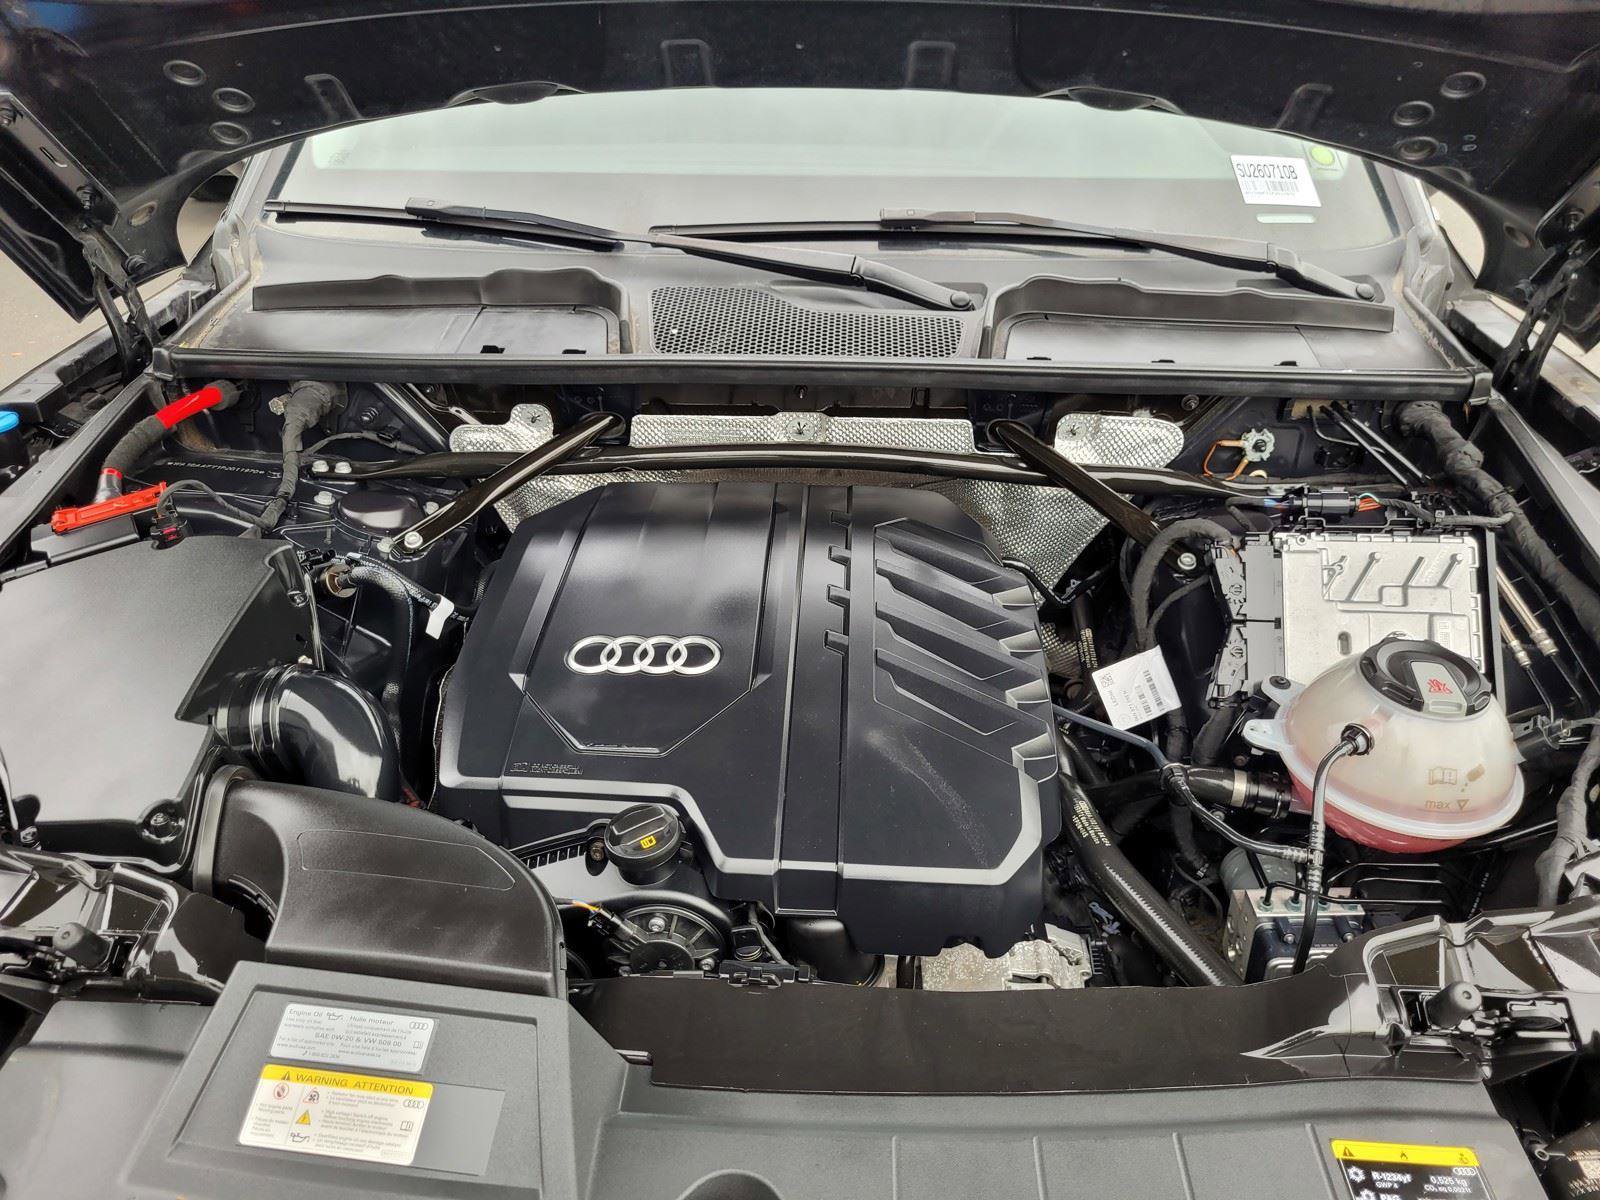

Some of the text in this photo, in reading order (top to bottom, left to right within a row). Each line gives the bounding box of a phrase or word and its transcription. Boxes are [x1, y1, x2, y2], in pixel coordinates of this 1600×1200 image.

[1425, 800, 1450, 810] max
[289, 1008, 312, 1017] Engine
[296, 1073, 414, 1095] WARNING ATTENTION
[1455, 1177, 1468, 1188] kg
